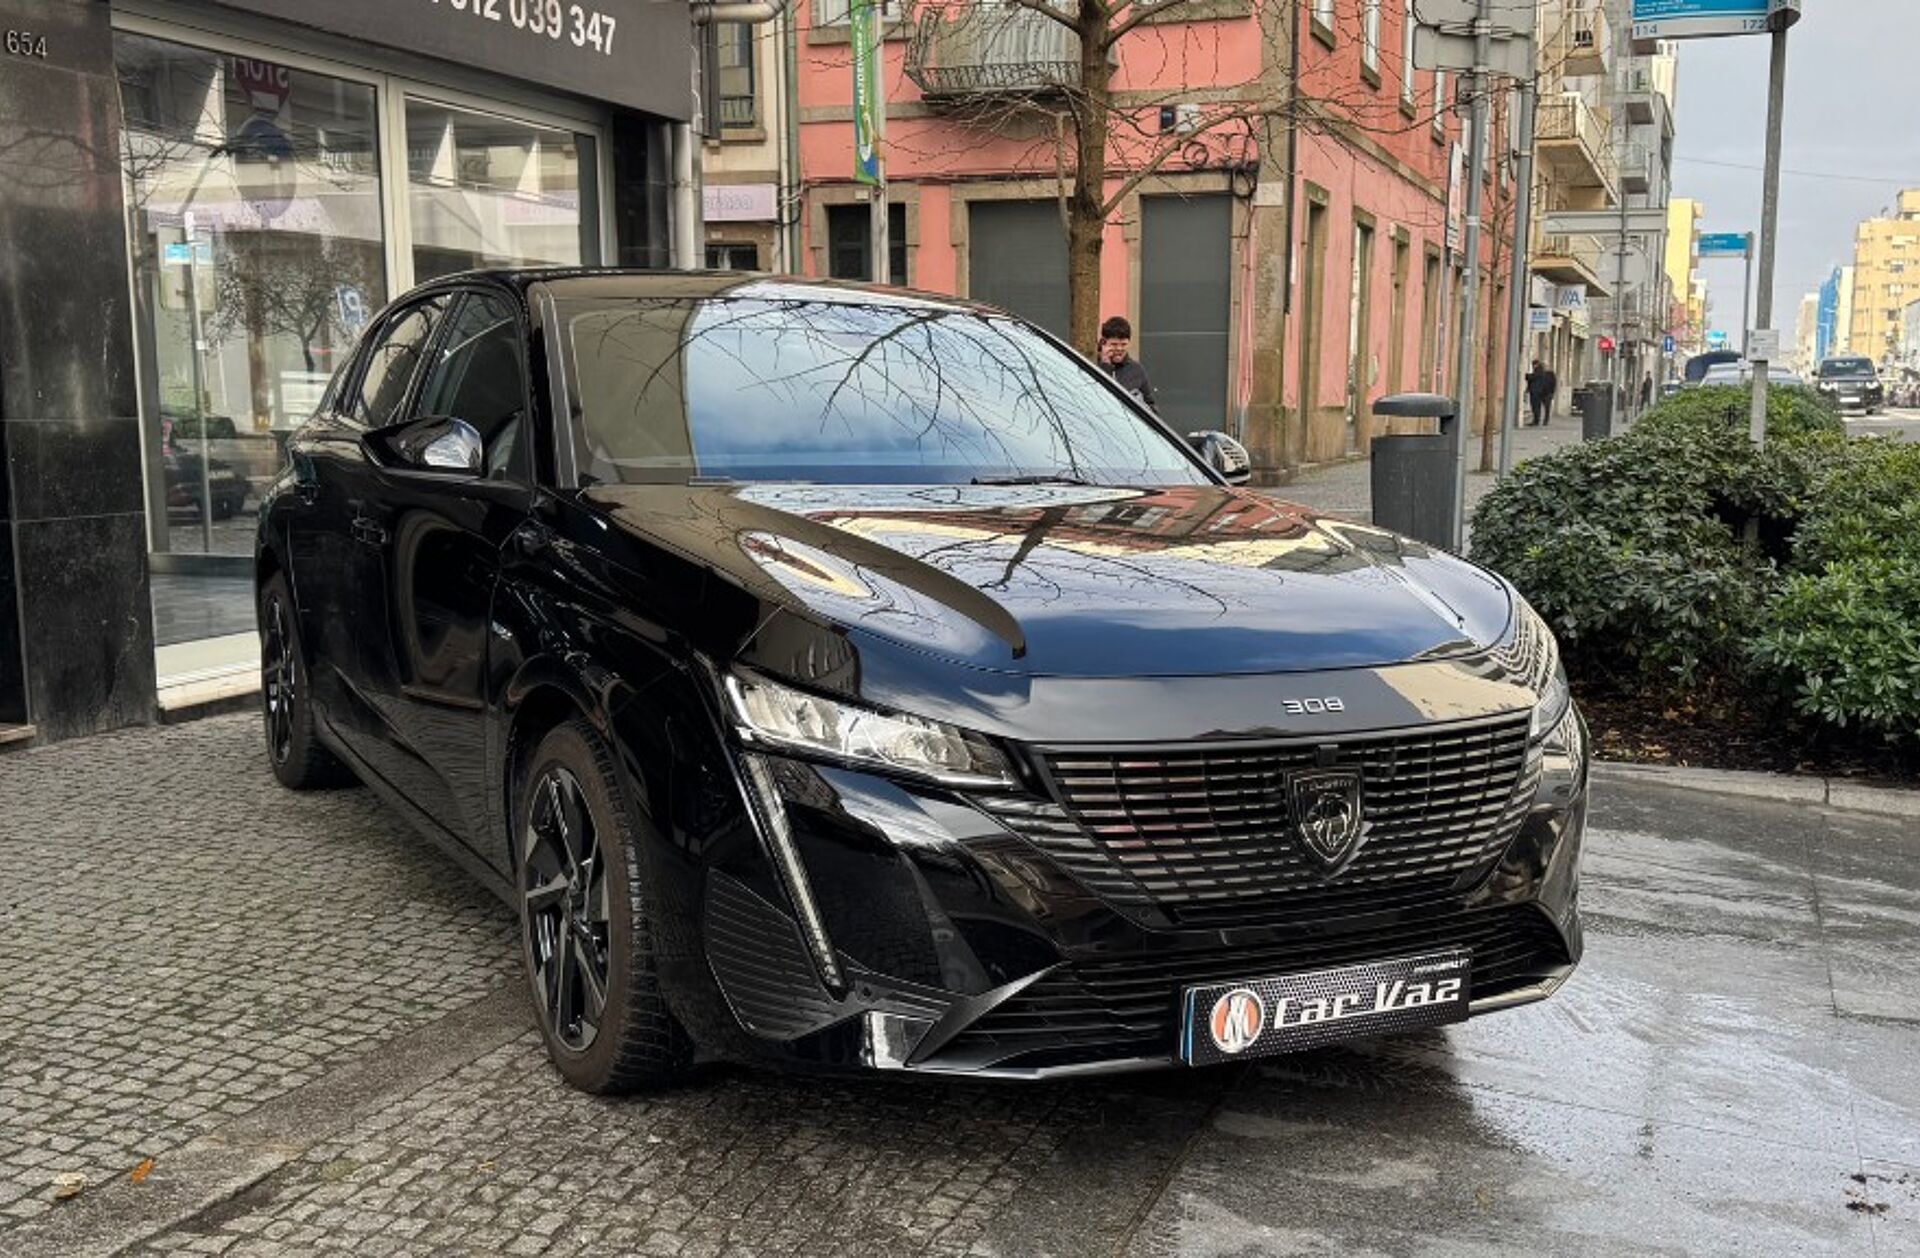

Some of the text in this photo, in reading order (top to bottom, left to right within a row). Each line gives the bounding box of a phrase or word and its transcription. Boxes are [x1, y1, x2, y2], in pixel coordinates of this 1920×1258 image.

[509, 0, 563, 39] 039
[570, 4, 616, 55] 347
[7, 30, 48, 58] 654
[1282, 697, 1345, 714] 308
[1274, 993, 1361, 1029] Car
